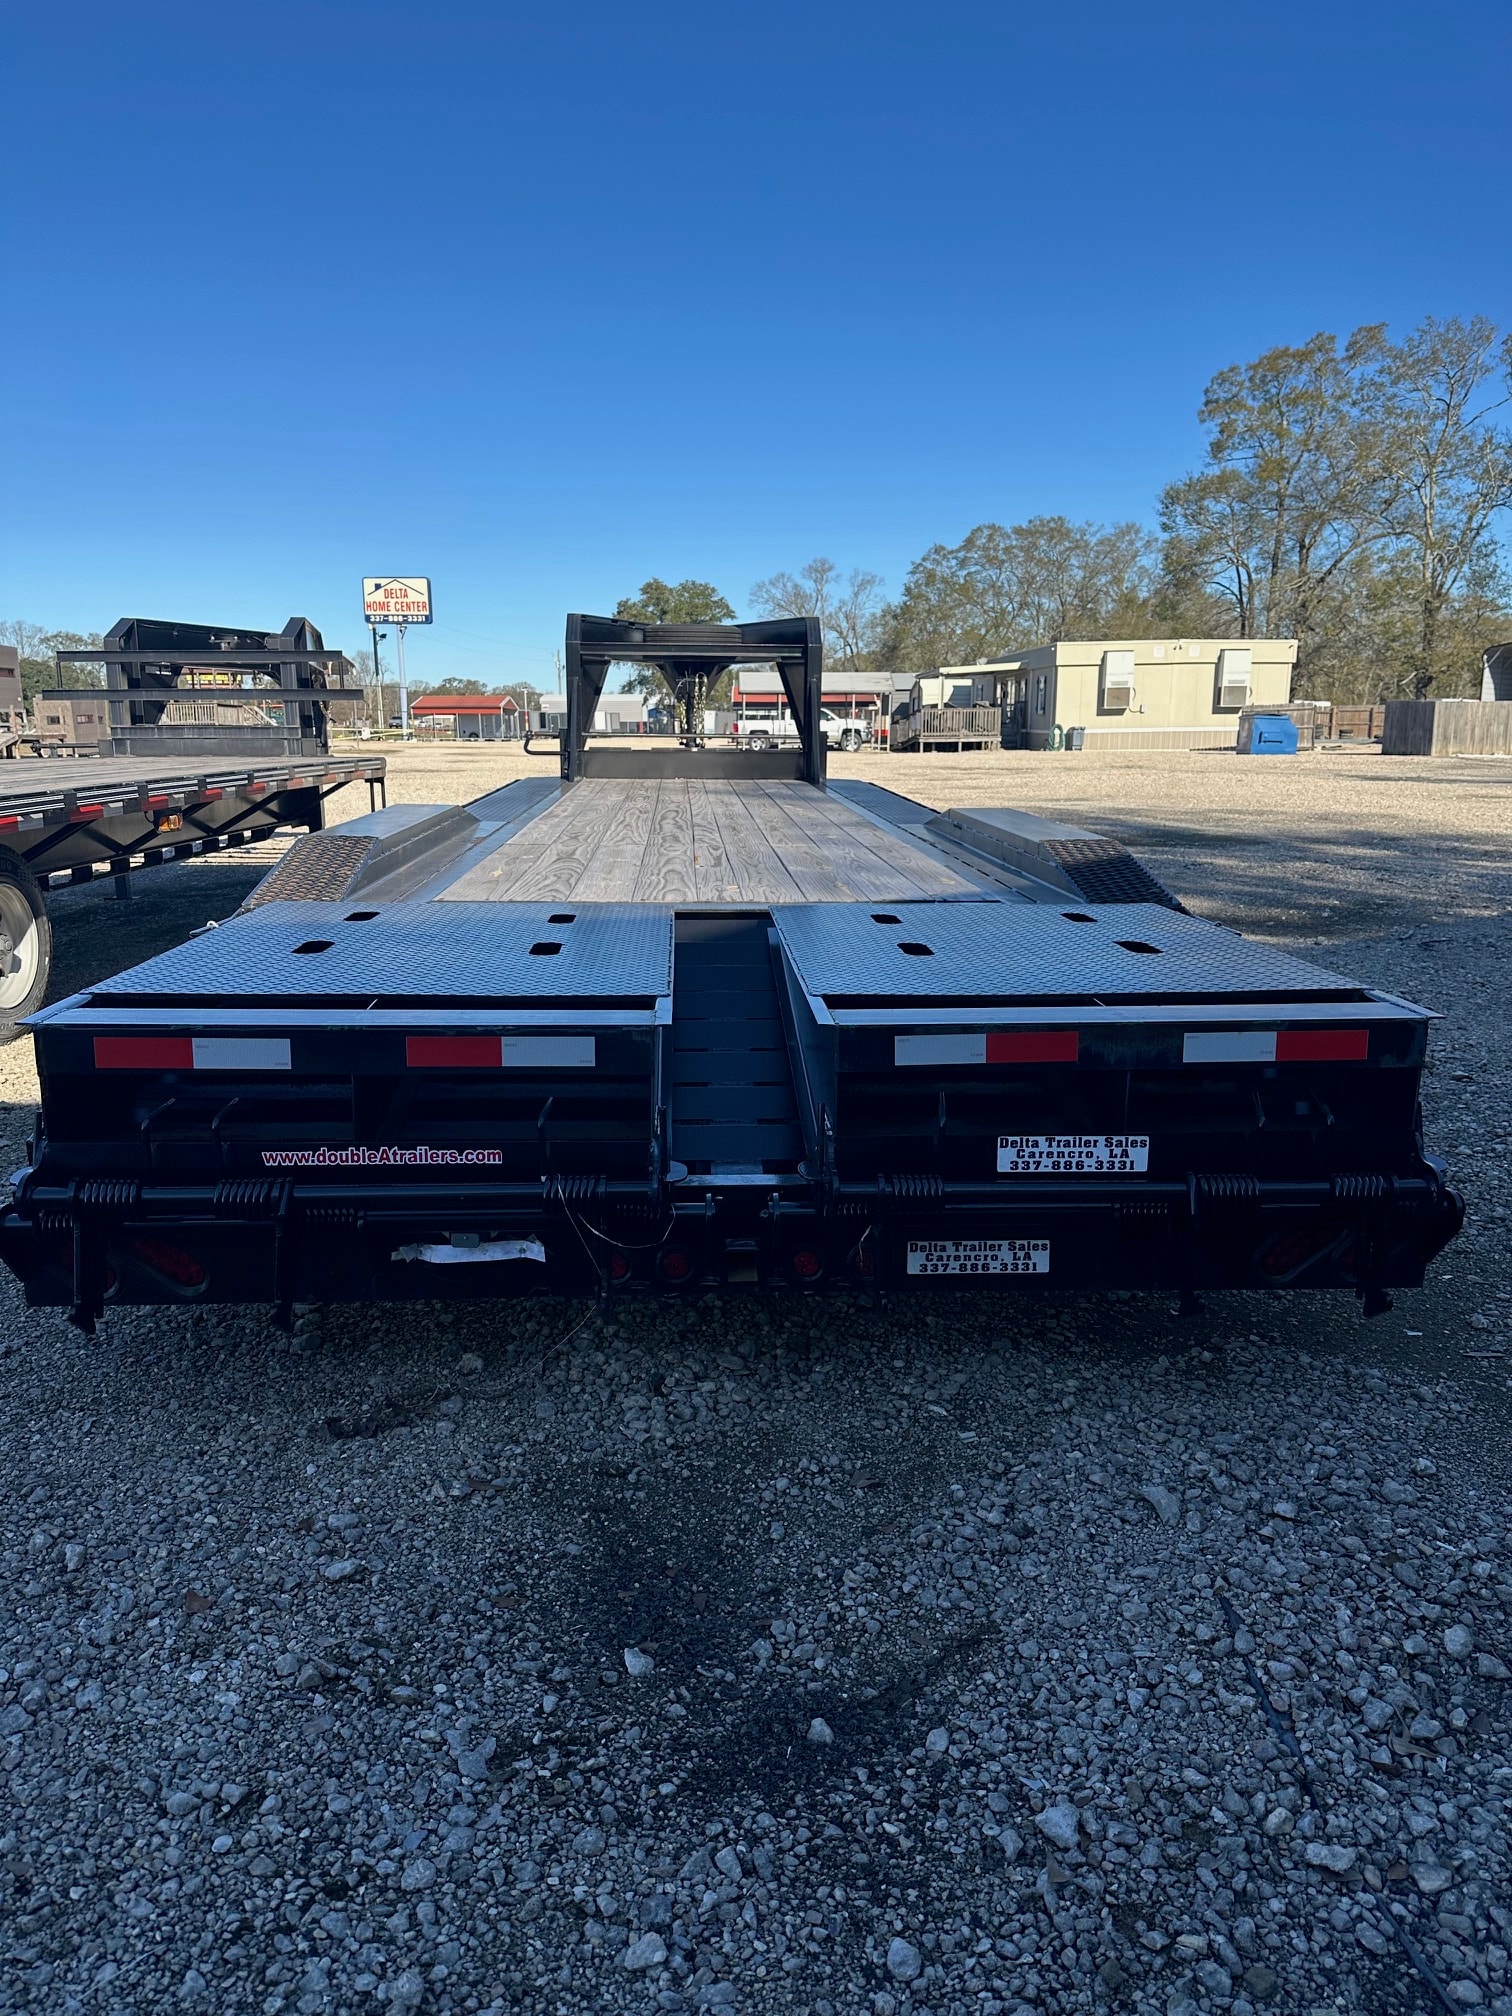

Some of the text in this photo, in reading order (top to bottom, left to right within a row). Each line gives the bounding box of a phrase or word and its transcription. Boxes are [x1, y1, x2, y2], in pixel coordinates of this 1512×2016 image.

[384, 588, 408, 599] DELTA
[366, 601, 427, 612] HOME CENTER
[1000, 1136, 1147, 1148] Delta Trailer Sales
[262, 1146, 502, 1166] www.doubleAtrailers.com
[1016, 1149, 1130, 1160] Carencro, LA
[1010, 1160, 1135, 1171] 337-886-3331
[909, 1240, 1048, 1253] Delta Trailer Sales
[1012, 1251, 1032, 1261] LA
[919, 1262, 1037, 1272] 337-886-3331
